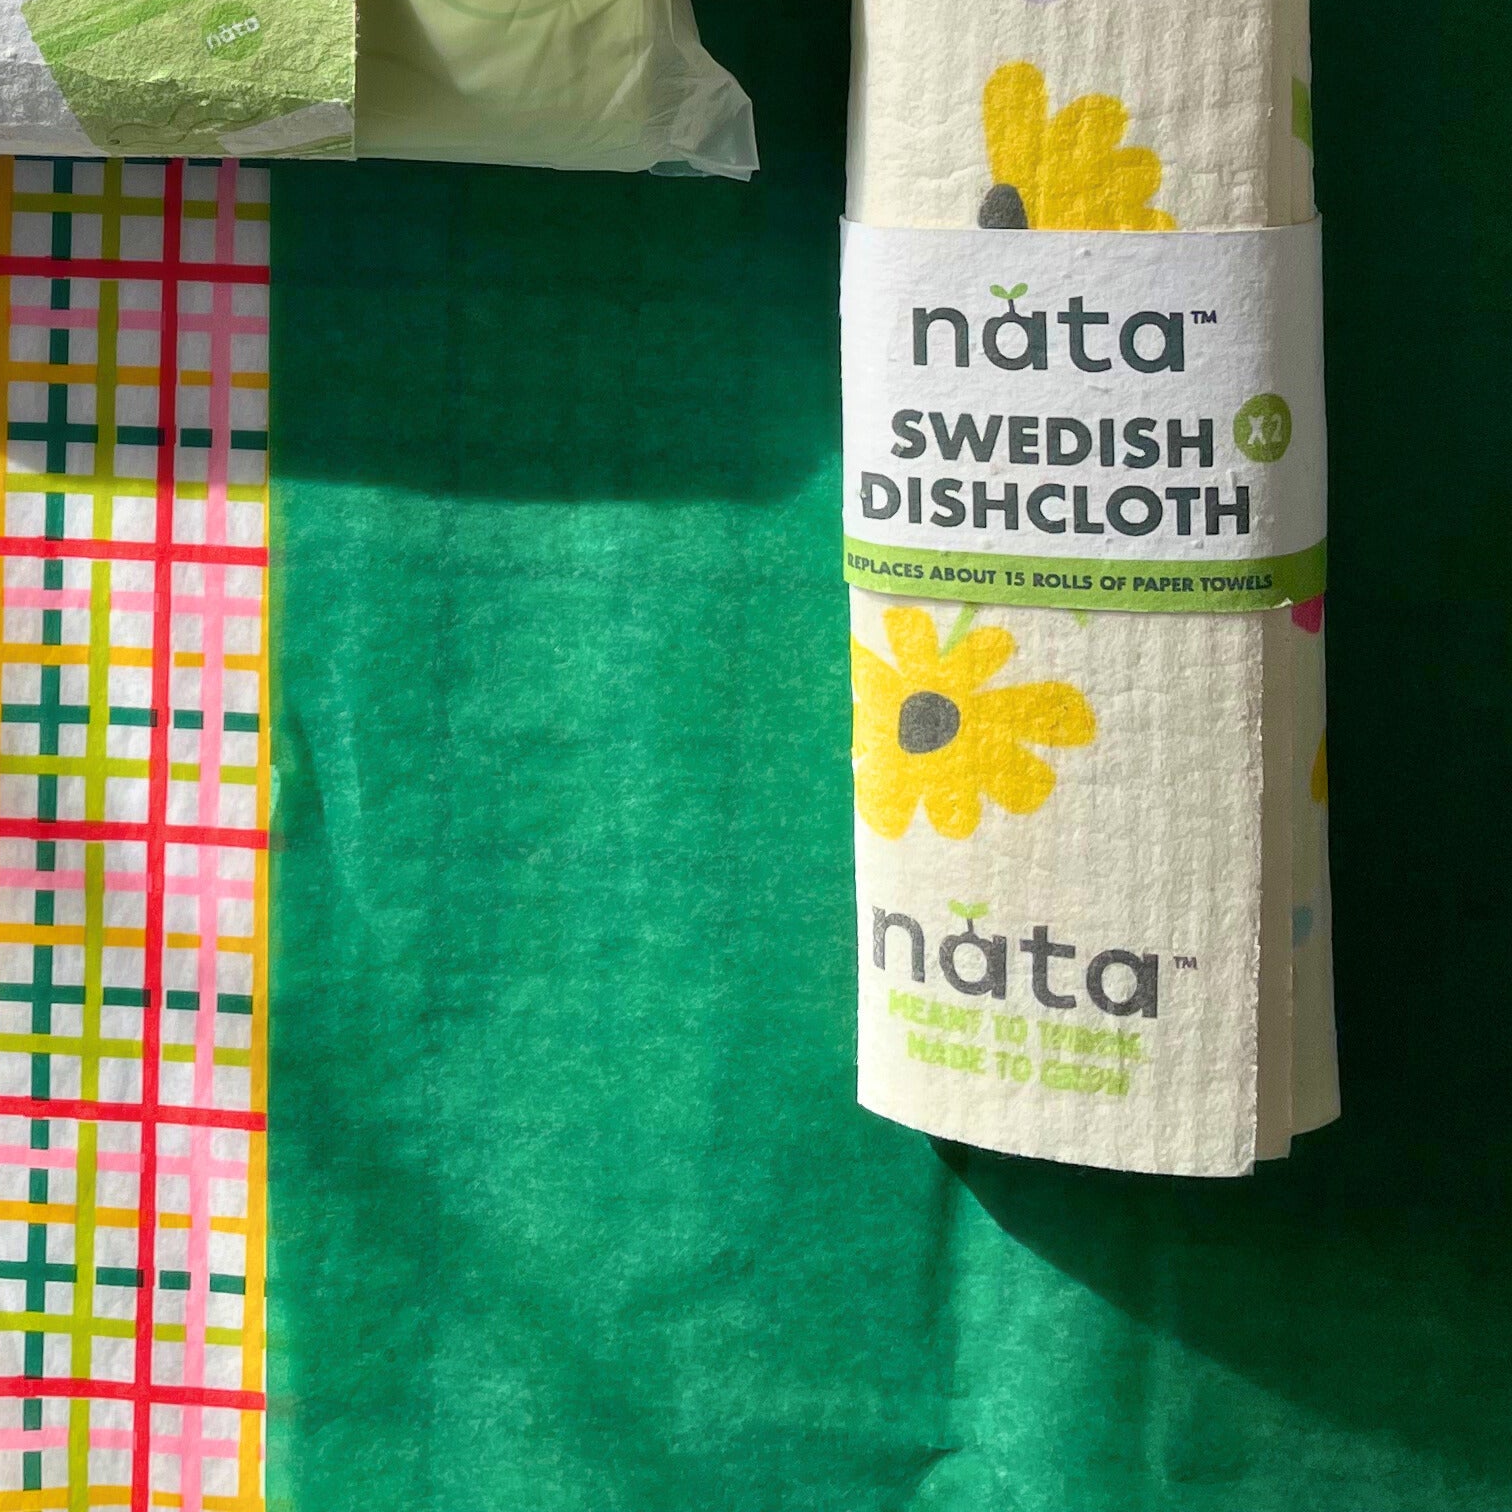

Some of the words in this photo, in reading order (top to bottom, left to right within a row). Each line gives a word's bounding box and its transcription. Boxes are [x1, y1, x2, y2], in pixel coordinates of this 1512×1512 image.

[890, 407, 1215, 470] SWEDISH
[859, 470, 1251, 538] DISHCLOTH
[847, 552, 924, 580] REPLACES
[929, 565, 997, 586] ABOUT
[1004, 571, 1026, 587] 15
[1032, 572, 1093, 590] ROLLS
[1099, 574, 1128, 592] OF
[1133, 576, 1195, 593] PAPER
[1199, 573, 1273, 592] TOWELS
[993, 1013, 1029, 1046] TO
[994, 1050, 1032, 1084] TO
